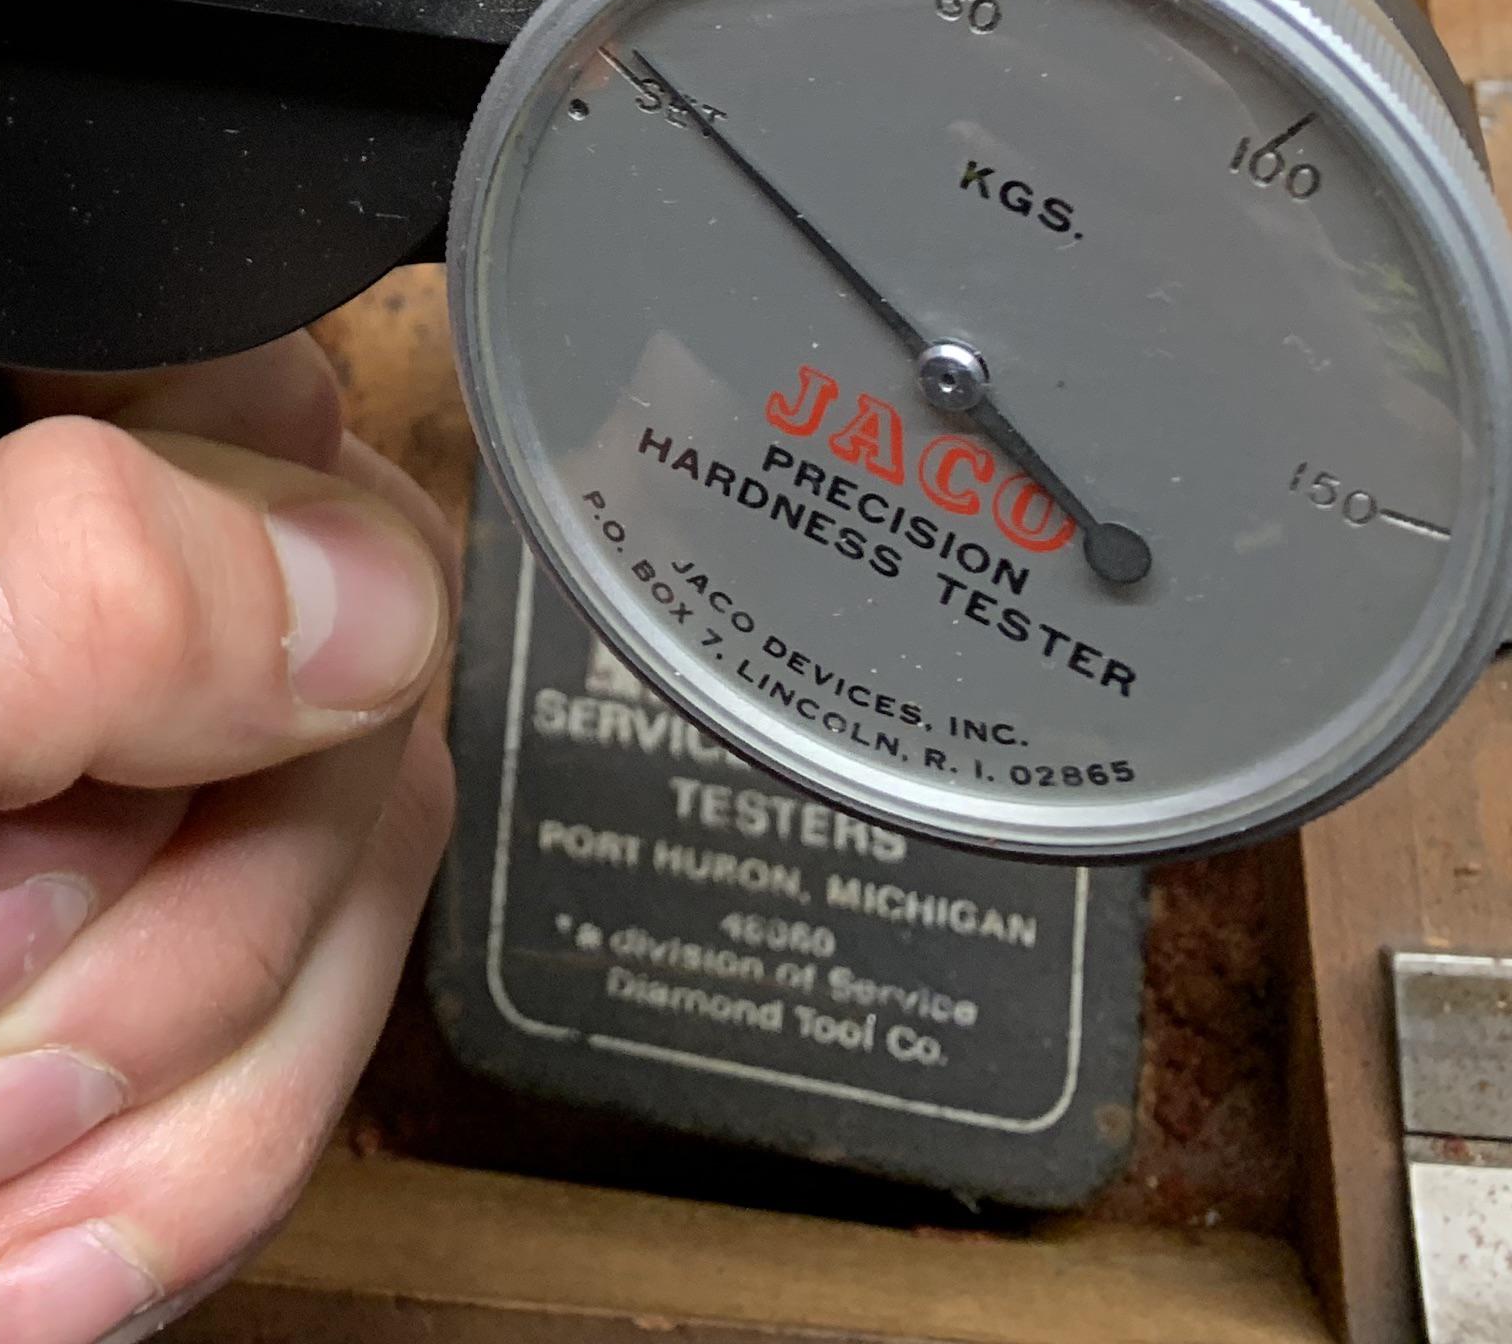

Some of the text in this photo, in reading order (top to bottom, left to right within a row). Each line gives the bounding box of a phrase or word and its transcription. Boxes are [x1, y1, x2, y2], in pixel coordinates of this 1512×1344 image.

[960, 160, 1084, 240] KGS.
[1230, 135, 1321, 202] 100
[765, 364, 1079, 553] JACO
[1289, 461, 1378, 528] 150
[638, 427, 1138, 698] HARDNESS TESTER
[762, 444, 1030, 596] PRECISION
[582, 490, 626, 553] P.O.
[631, 559, 693, 624] BOX
[923, 747, 958, 774] R.
[1009, 759, 1136, 787] 02865
[671, 561, 1030, 746] JACO DEVICES, INC.
[669, 776, 907, 863] TESTERS
[539, 819, 1037, 949] PORT HURON, MICHIGAN
[606, 966, 949, 1067] Diamond Tool Co.
[609, 926, 765, 981] division
[775, 962, 817, 993] of
[828, 965, 979, 1026] Service
